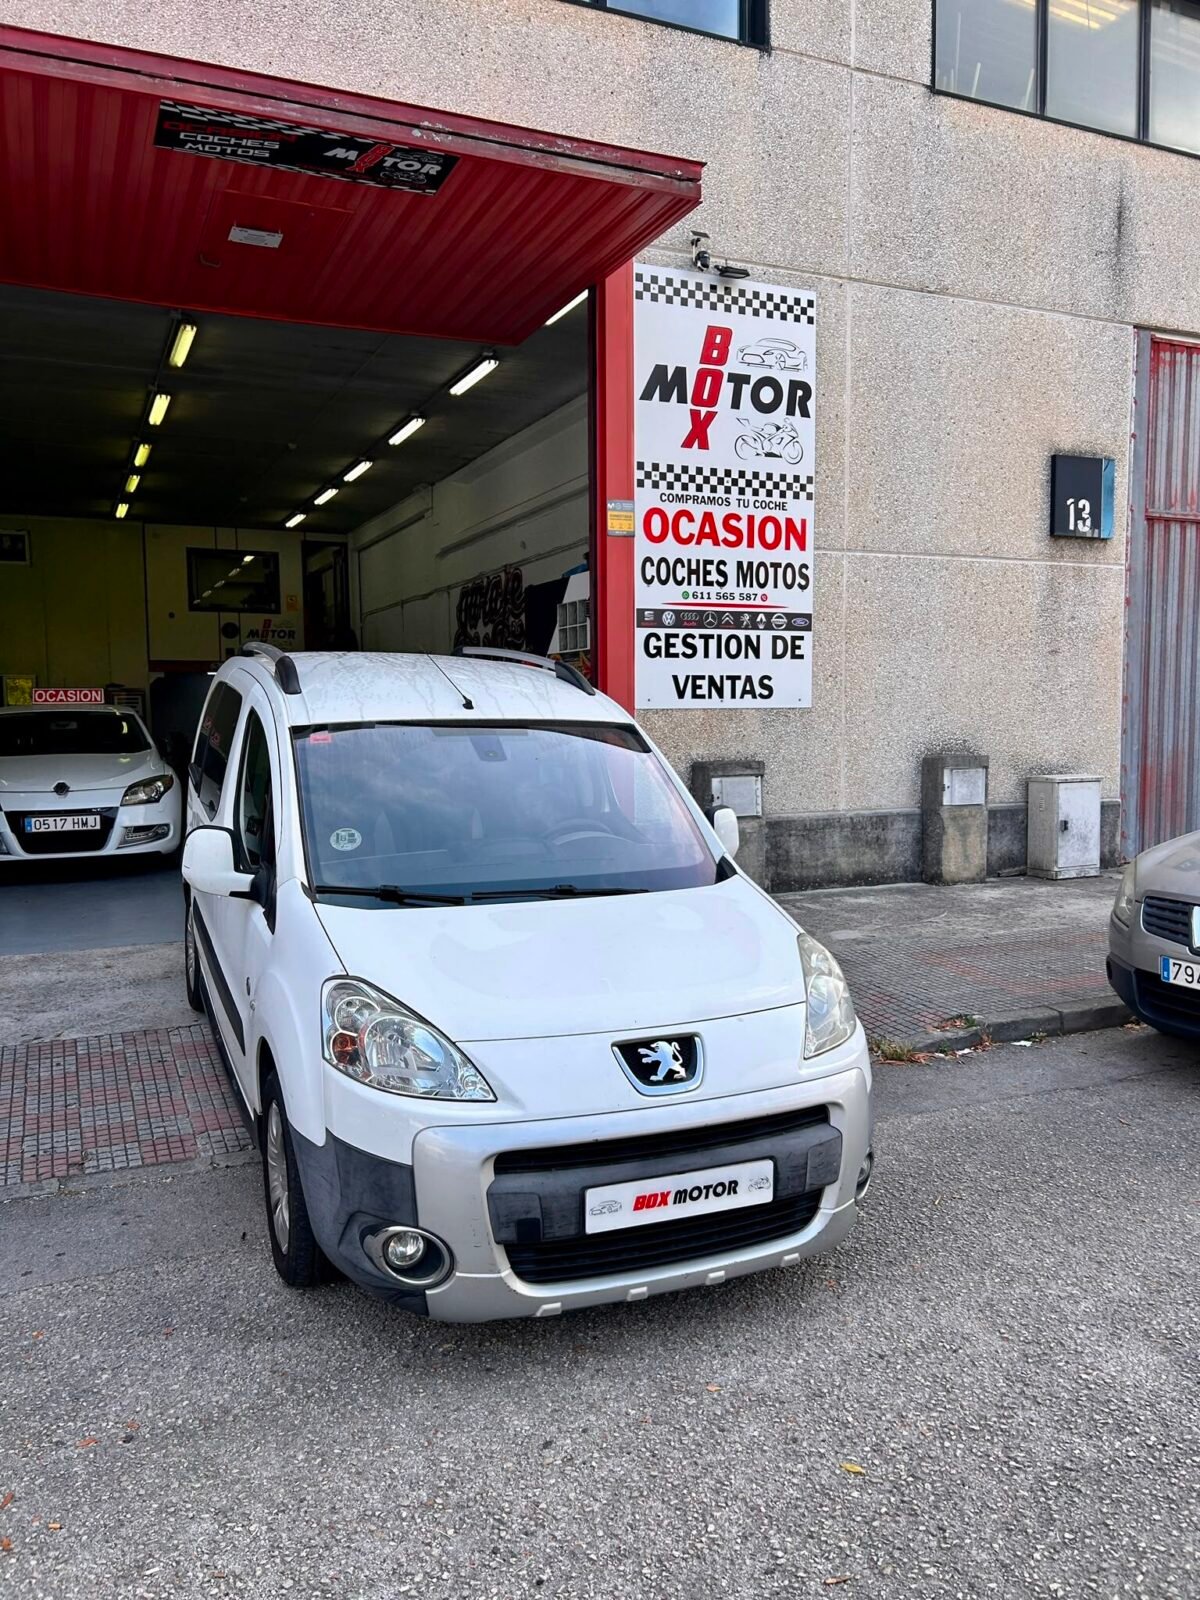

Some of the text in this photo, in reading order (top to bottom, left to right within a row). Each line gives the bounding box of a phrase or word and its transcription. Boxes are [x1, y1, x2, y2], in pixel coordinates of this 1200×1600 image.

[179, 132, 280, 149] COCHES
[184, 142, 270, 158] MOTOS
[639, 364, 812, 418] MOTOR
[681, 325, 733, 450] BOX
[659, 492, 788, 511] COMPRAMOS TU COCHE
[1066, 498, 1092, 532] 13
[642, 507, 807, 552] OCASION
[641, 556, 810, 591] COCHES MOTOS
[692, 591, 758, 602] 611 565 587
[643, 632, 805, 660] GESTION DE
[34, 689, 102, 702] OCASION
[672, 674, 774, 700] VENTAS
[34, 817, 98, 831] 0517 HMJ
[633, 1180, 739, 1211] BOX MOTOR
